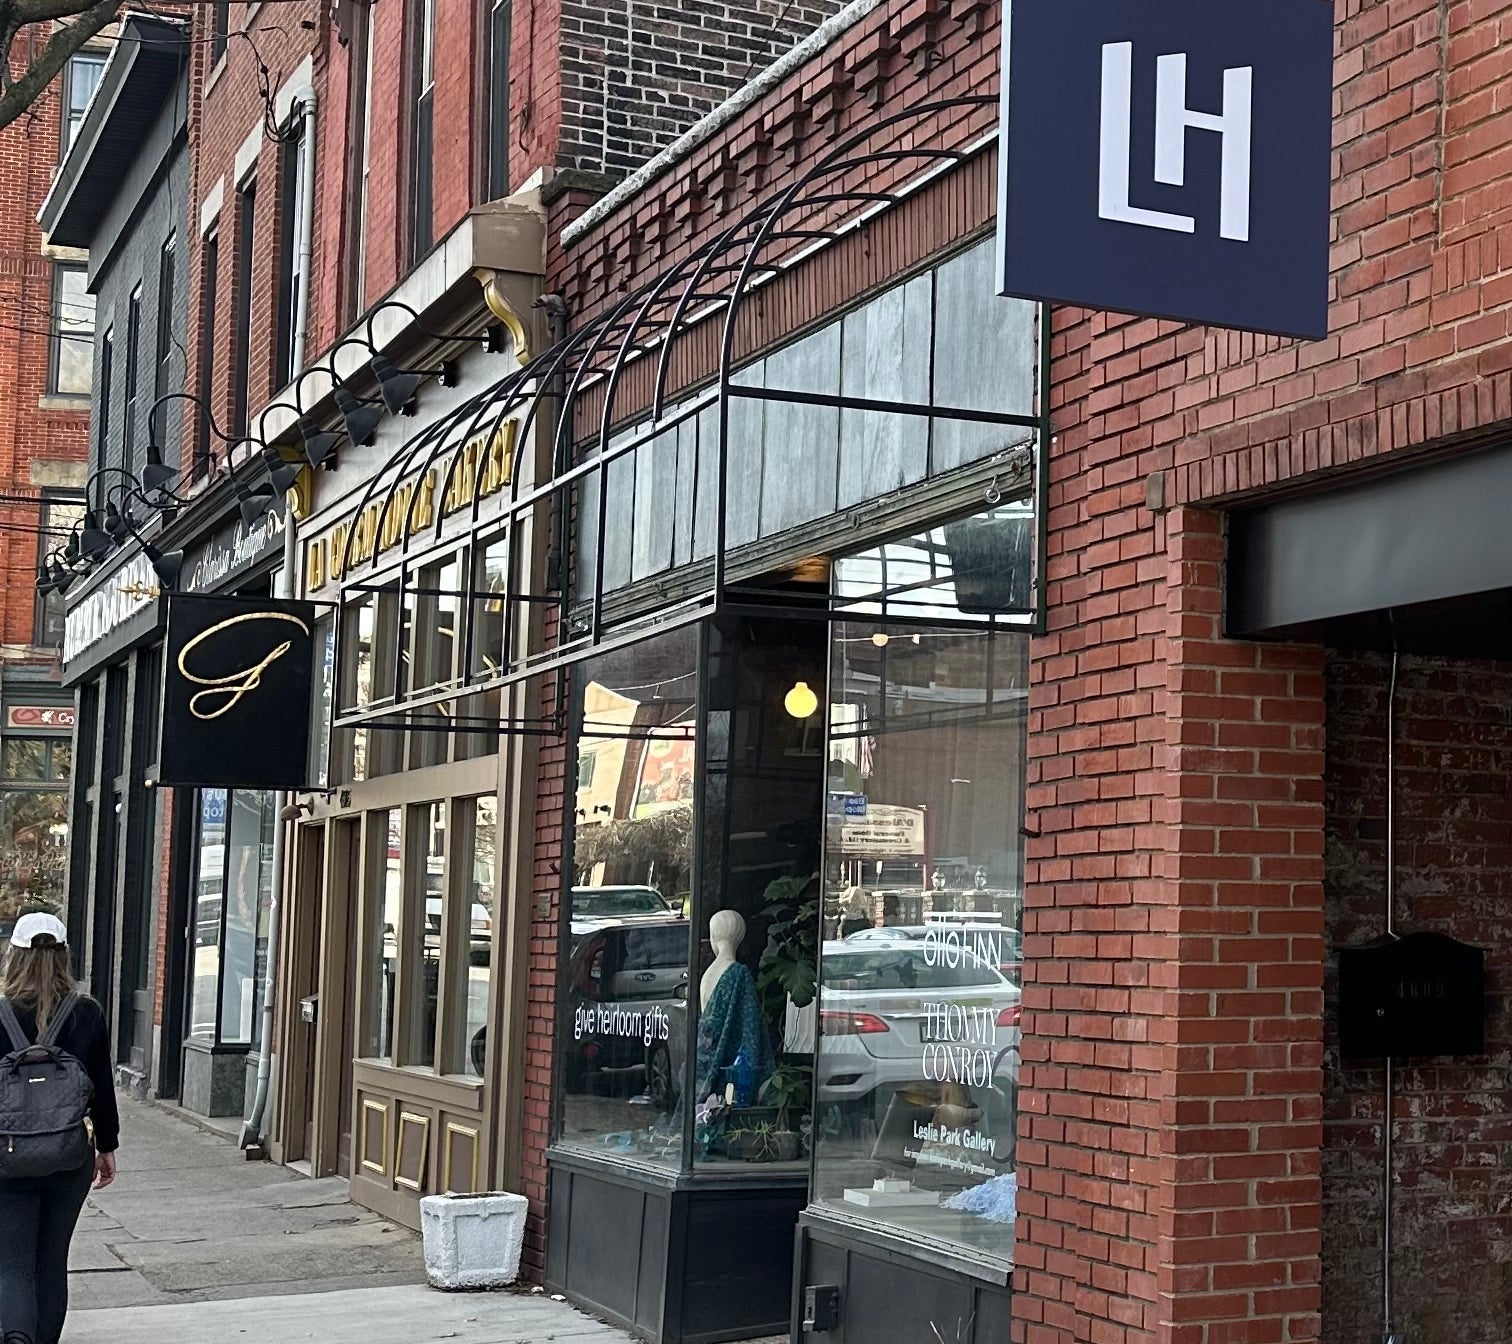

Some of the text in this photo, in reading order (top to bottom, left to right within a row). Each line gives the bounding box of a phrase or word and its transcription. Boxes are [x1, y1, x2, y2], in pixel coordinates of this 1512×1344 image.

[1099, 41, 1252, 241] LH
[574, 1001, 669, 1047] give heirloom gifts
[923, 1002, 1001, 1046] THOMMY
[922, 1043, 998, 1089] CONROY
[913, 1119, 997, 1157] Leslie Park Gallery
